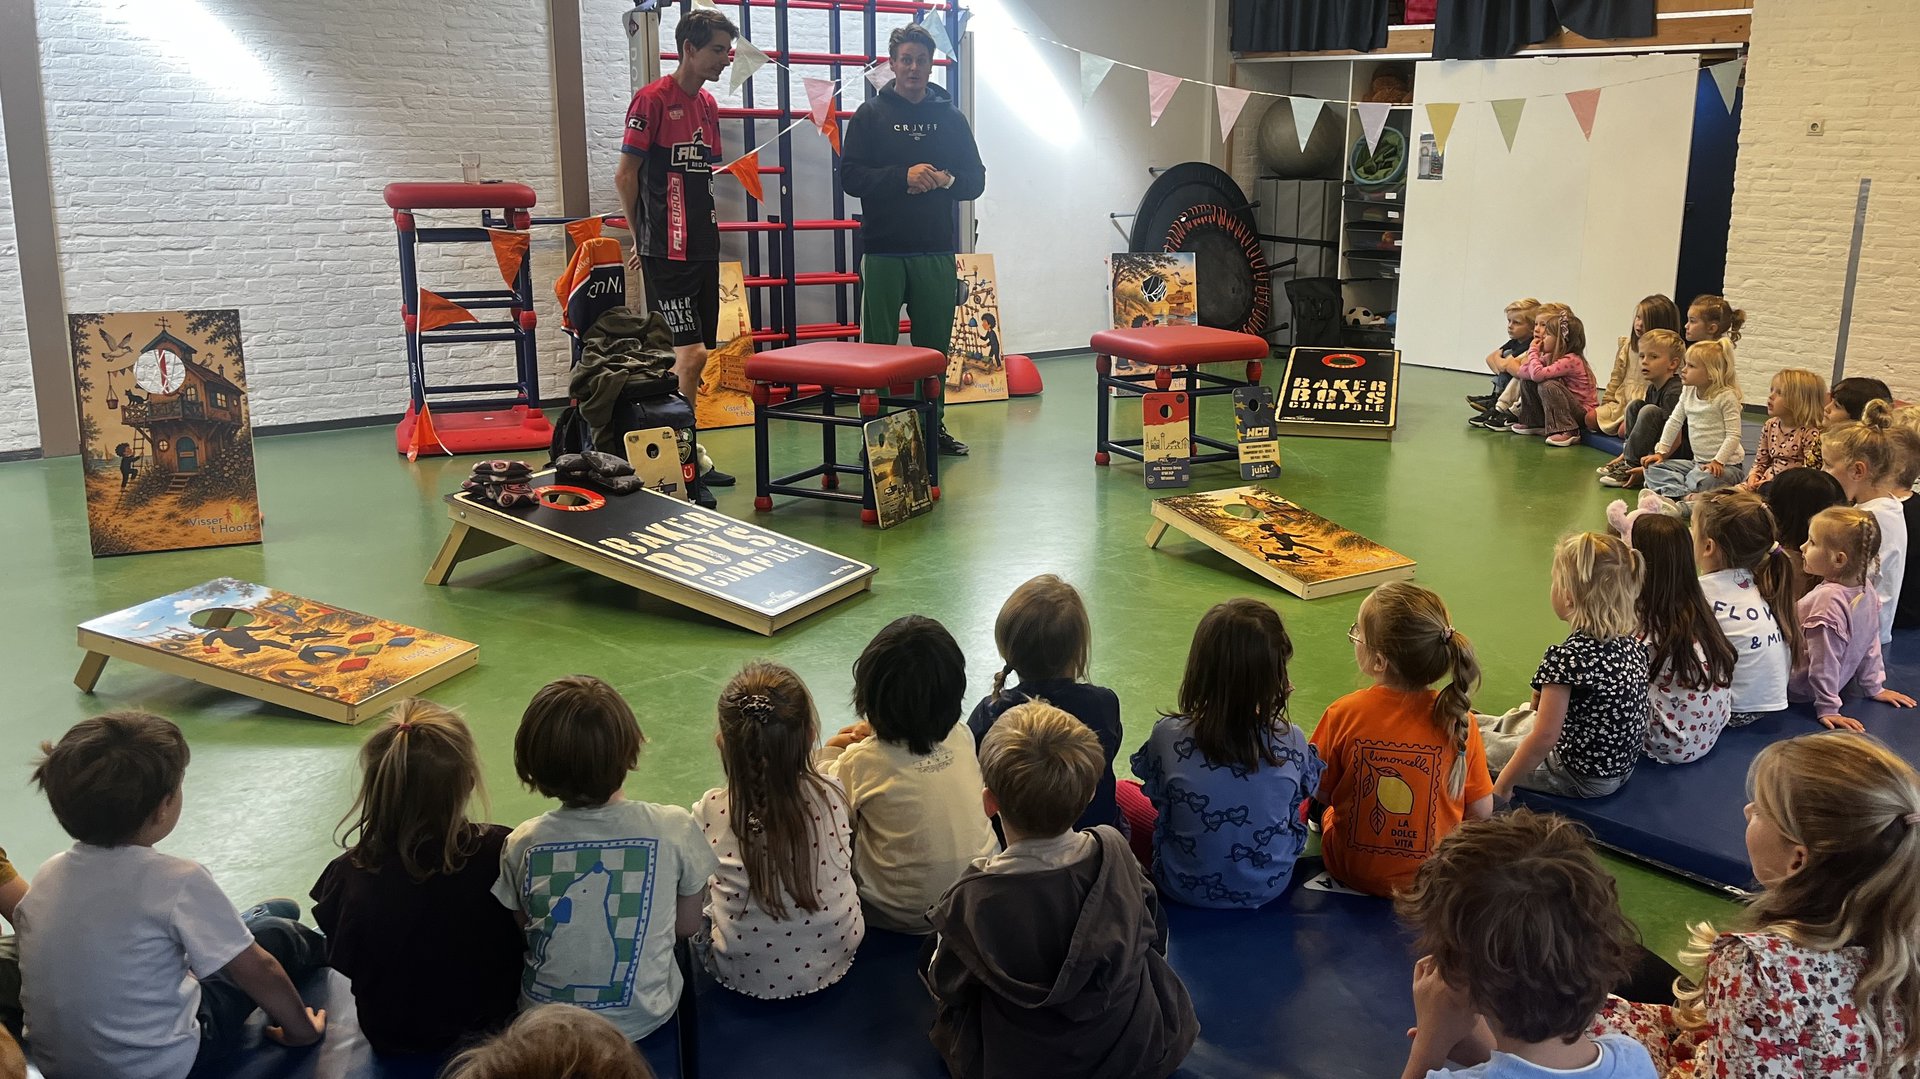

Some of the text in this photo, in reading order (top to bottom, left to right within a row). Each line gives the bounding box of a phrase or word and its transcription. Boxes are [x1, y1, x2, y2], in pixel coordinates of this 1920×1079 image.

[671, 177, 682, 251] ACL EUROPE
[1293, 377, 1387, 392] BAKER
[1290, 388, 1386, 405] BOYS
[1251, 465, 1271, 477] juist
[188, 517, 223, 526] Visser
[220, 522, 257, 533] Hooft
[598, 510, 729, 556] BAKER
[643, 525, 778, 577] BOYS
[1750, 636, 1762, 650] &
[1369, 750, 1431, 776] limoncella
[1398, 819, 1409, 827] LA
[1391, 829, 1418, 839] DOLCE
[1394, 839, 1414, 849] VITA
